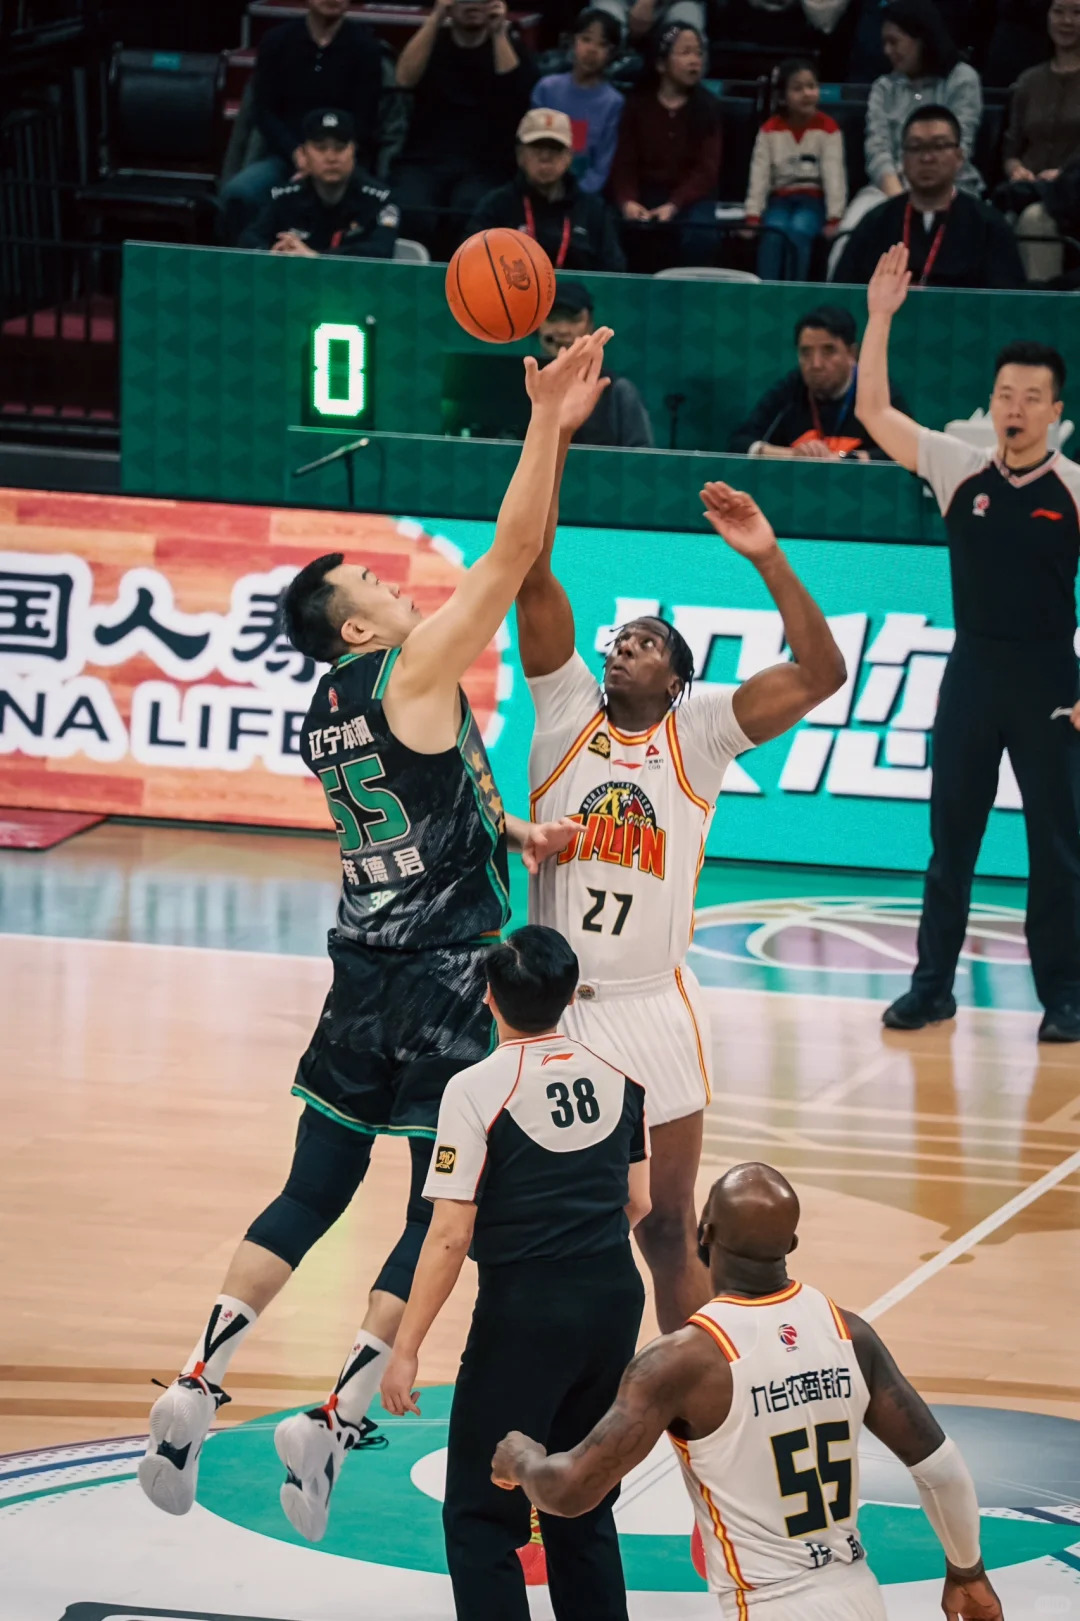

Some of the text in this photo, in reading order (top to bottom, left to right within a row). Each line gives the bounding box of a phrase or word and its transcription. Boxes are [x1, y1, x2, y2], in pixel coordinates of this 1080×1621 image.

[313, 322, 365, 417] 0
[148, 701, 307, 757] LIFE
[308, 715, 374, 761] 辽宁本钢
[318, 753, 411, 854] 55
[556, 813, 667, 881] JILIN
[582, 886, 634, 936] 27
[546, 1077, 601, 1129] 38
[769, 1419, 853, 1539] 55
